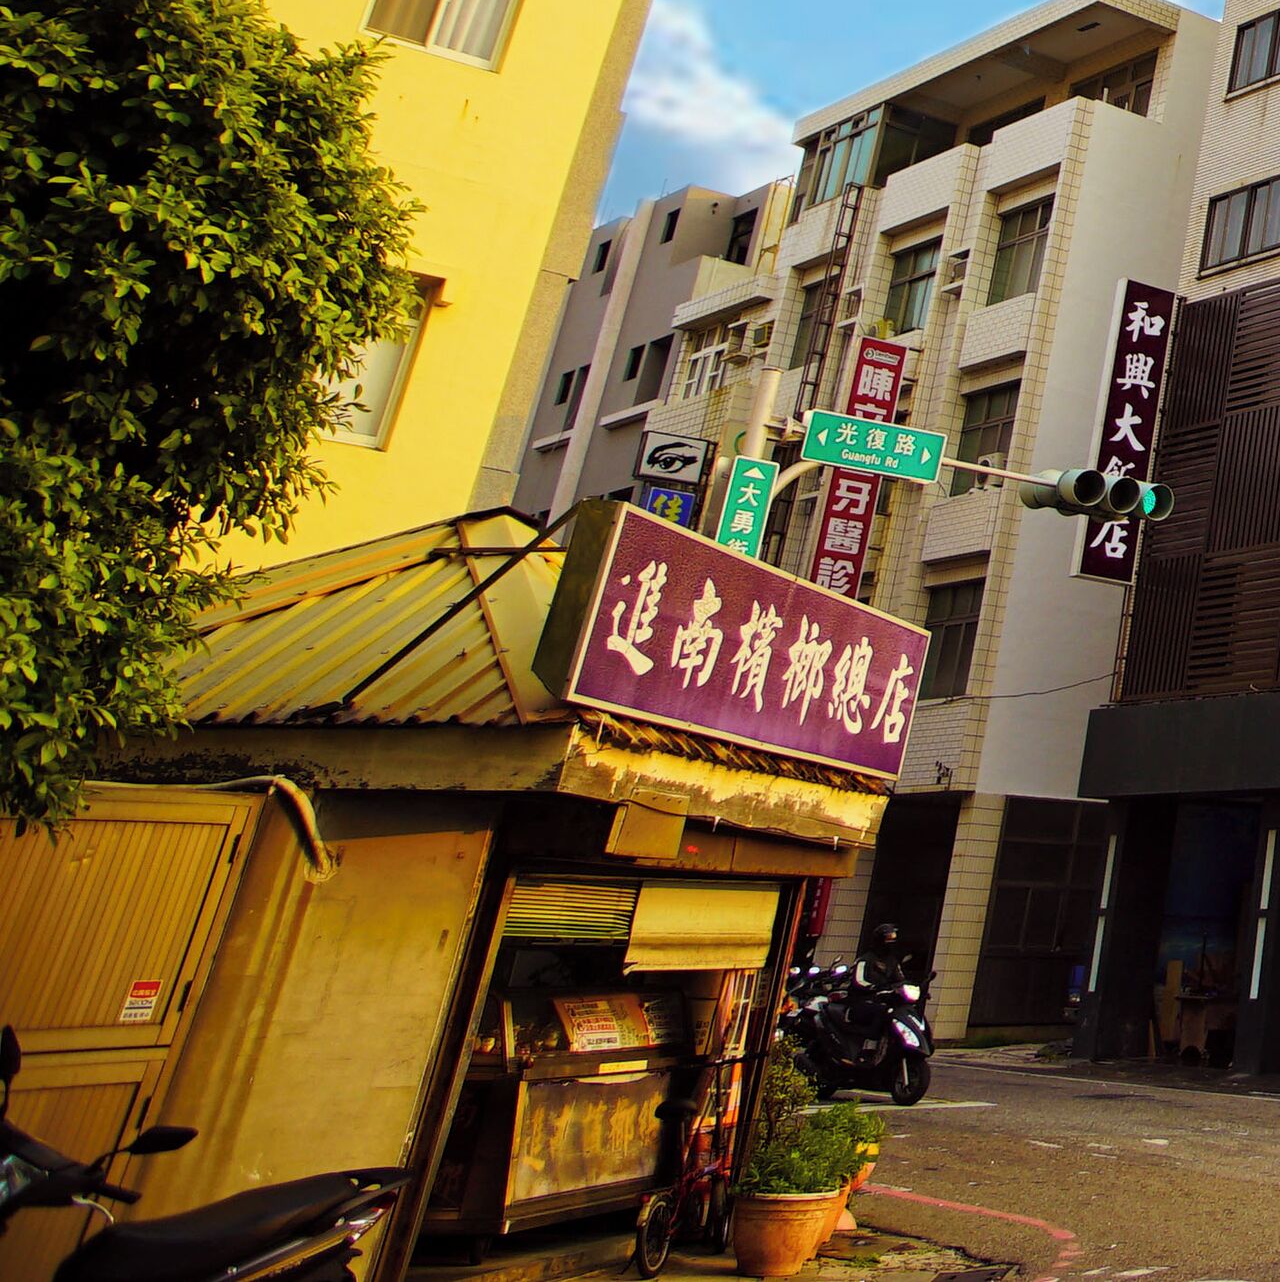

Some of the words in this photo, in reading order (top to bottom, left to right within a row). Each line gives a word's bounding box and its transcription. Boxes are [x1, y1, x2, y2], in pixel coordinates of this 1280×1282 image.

[835, 422, 916, 456] 光復路
[841, 448, 881, 465] Guangfu
[884, 455, 899, 468] Rd
